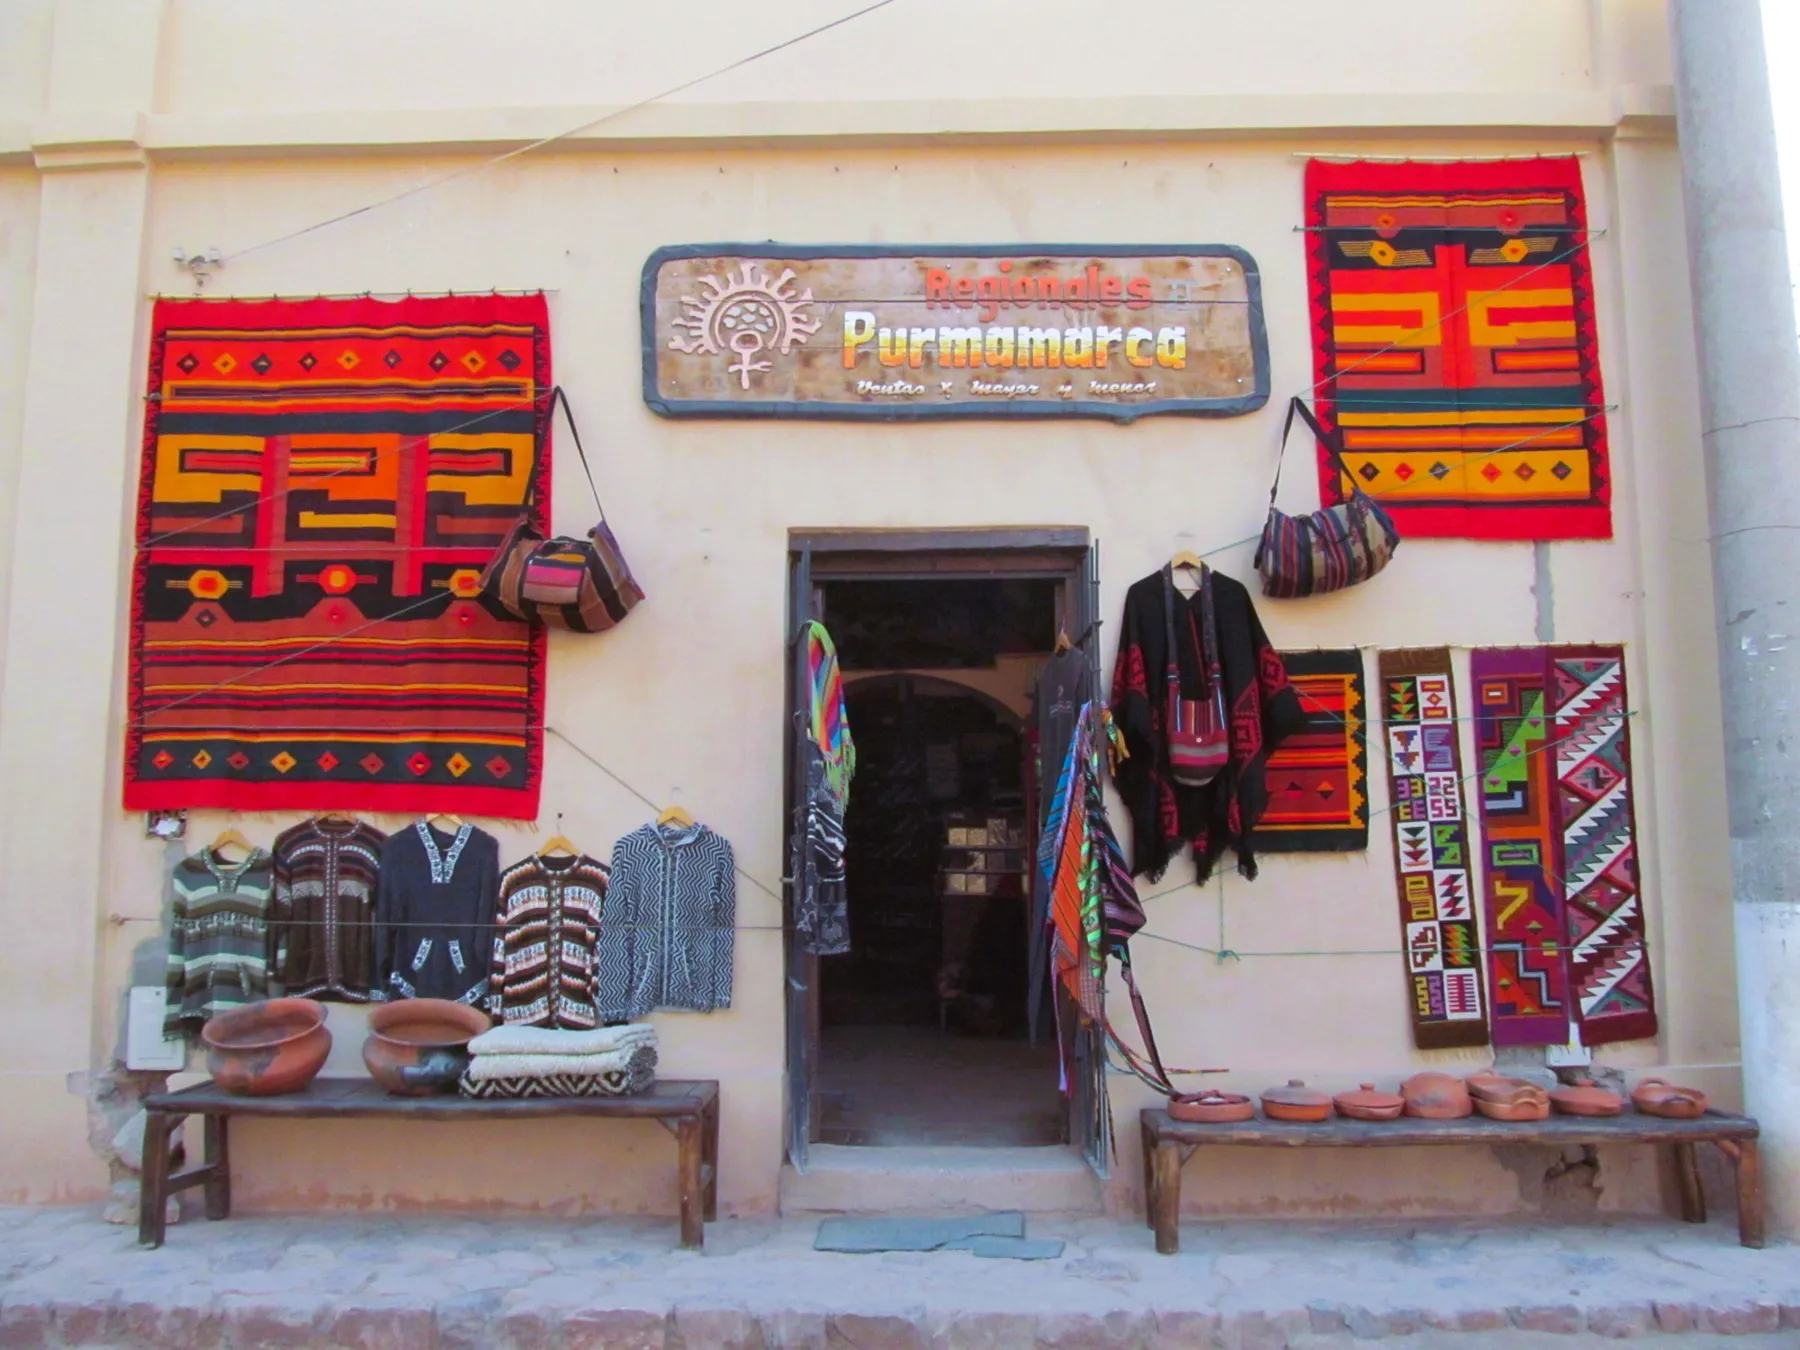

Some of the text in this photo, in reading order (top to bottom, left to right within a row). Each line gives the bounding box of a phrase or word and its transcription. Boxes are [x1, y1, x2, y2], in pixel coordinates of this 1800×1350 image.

[925, 261, 1154, 323] Regionales
[842, 310, 1187, 370] Purmamarca
[856, 380, 926, 396] Ventas
